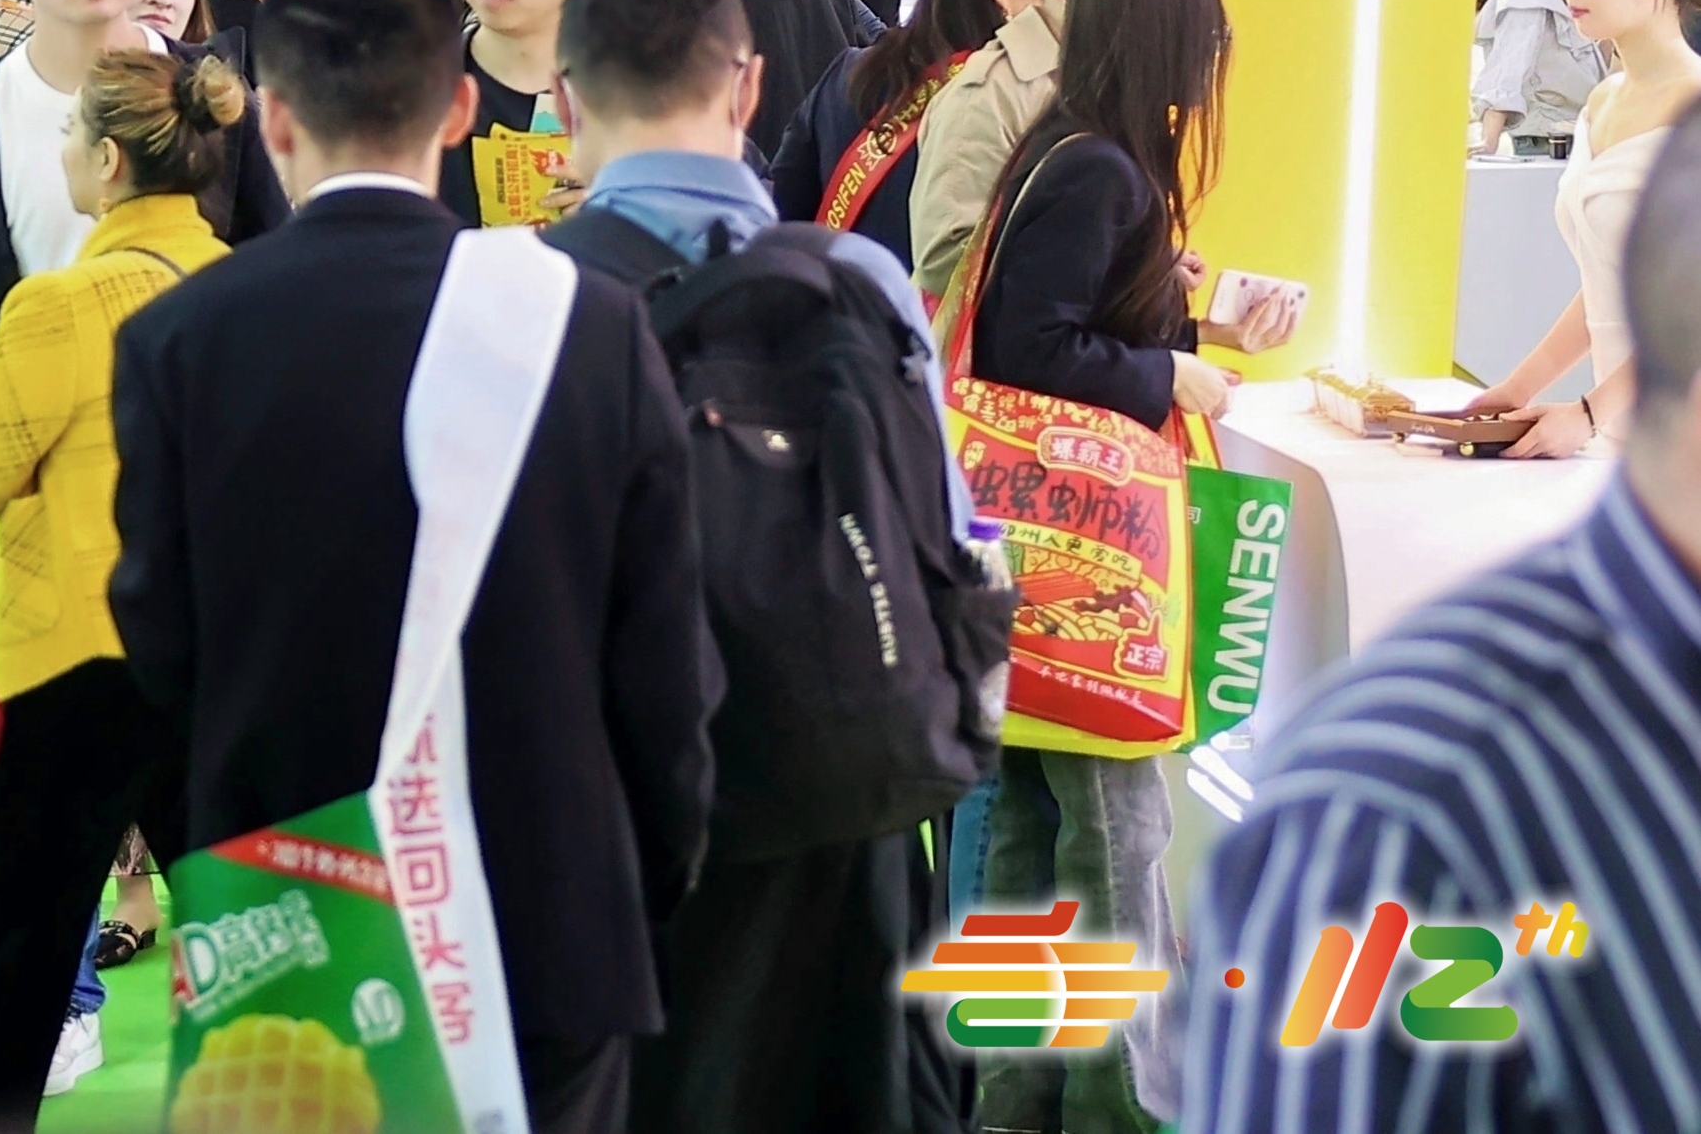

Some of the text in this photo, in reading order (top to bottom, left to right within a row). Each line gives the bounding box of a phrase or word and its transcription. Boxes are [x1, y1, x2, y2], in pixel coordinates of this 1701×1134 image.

[1050, 436, 1124, 474] 螺霸王
[1207, 499, 1287, 714] SENWU
[1122, 642, 1165, 671] 正宗
